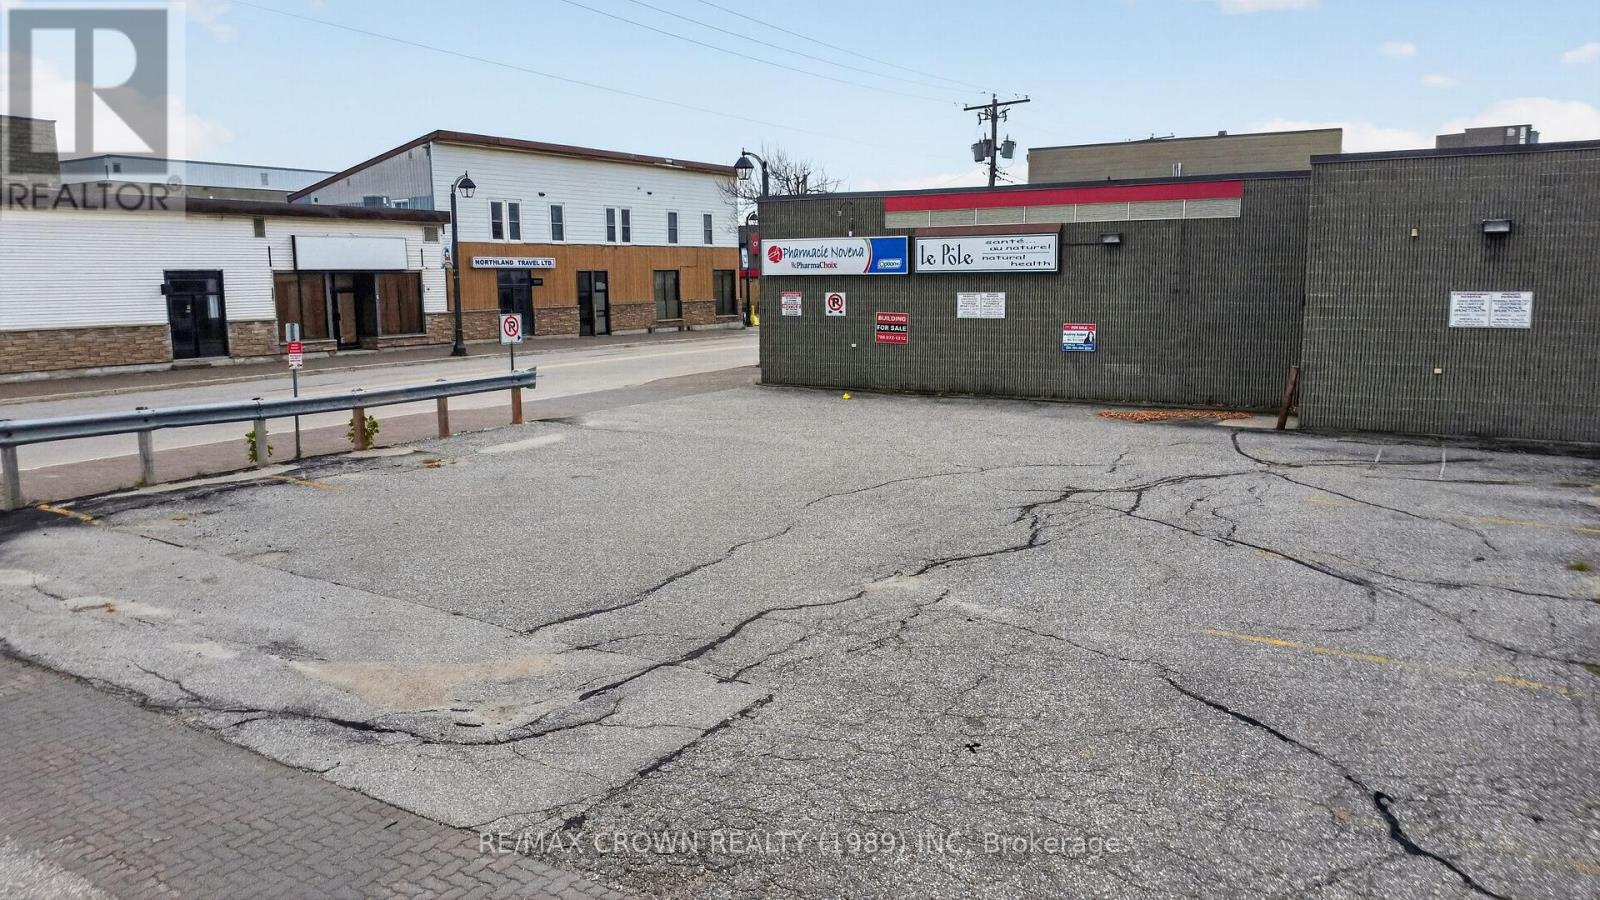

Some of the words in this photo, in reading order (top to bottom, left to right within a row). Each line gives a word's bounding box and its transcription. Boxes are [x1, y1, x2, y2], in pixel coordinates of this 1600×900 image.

[782, 245, 829, 259] Pharmacie
[831, 246, 864, 258] Novena
[1005, 243, 1051, 251] naturel
